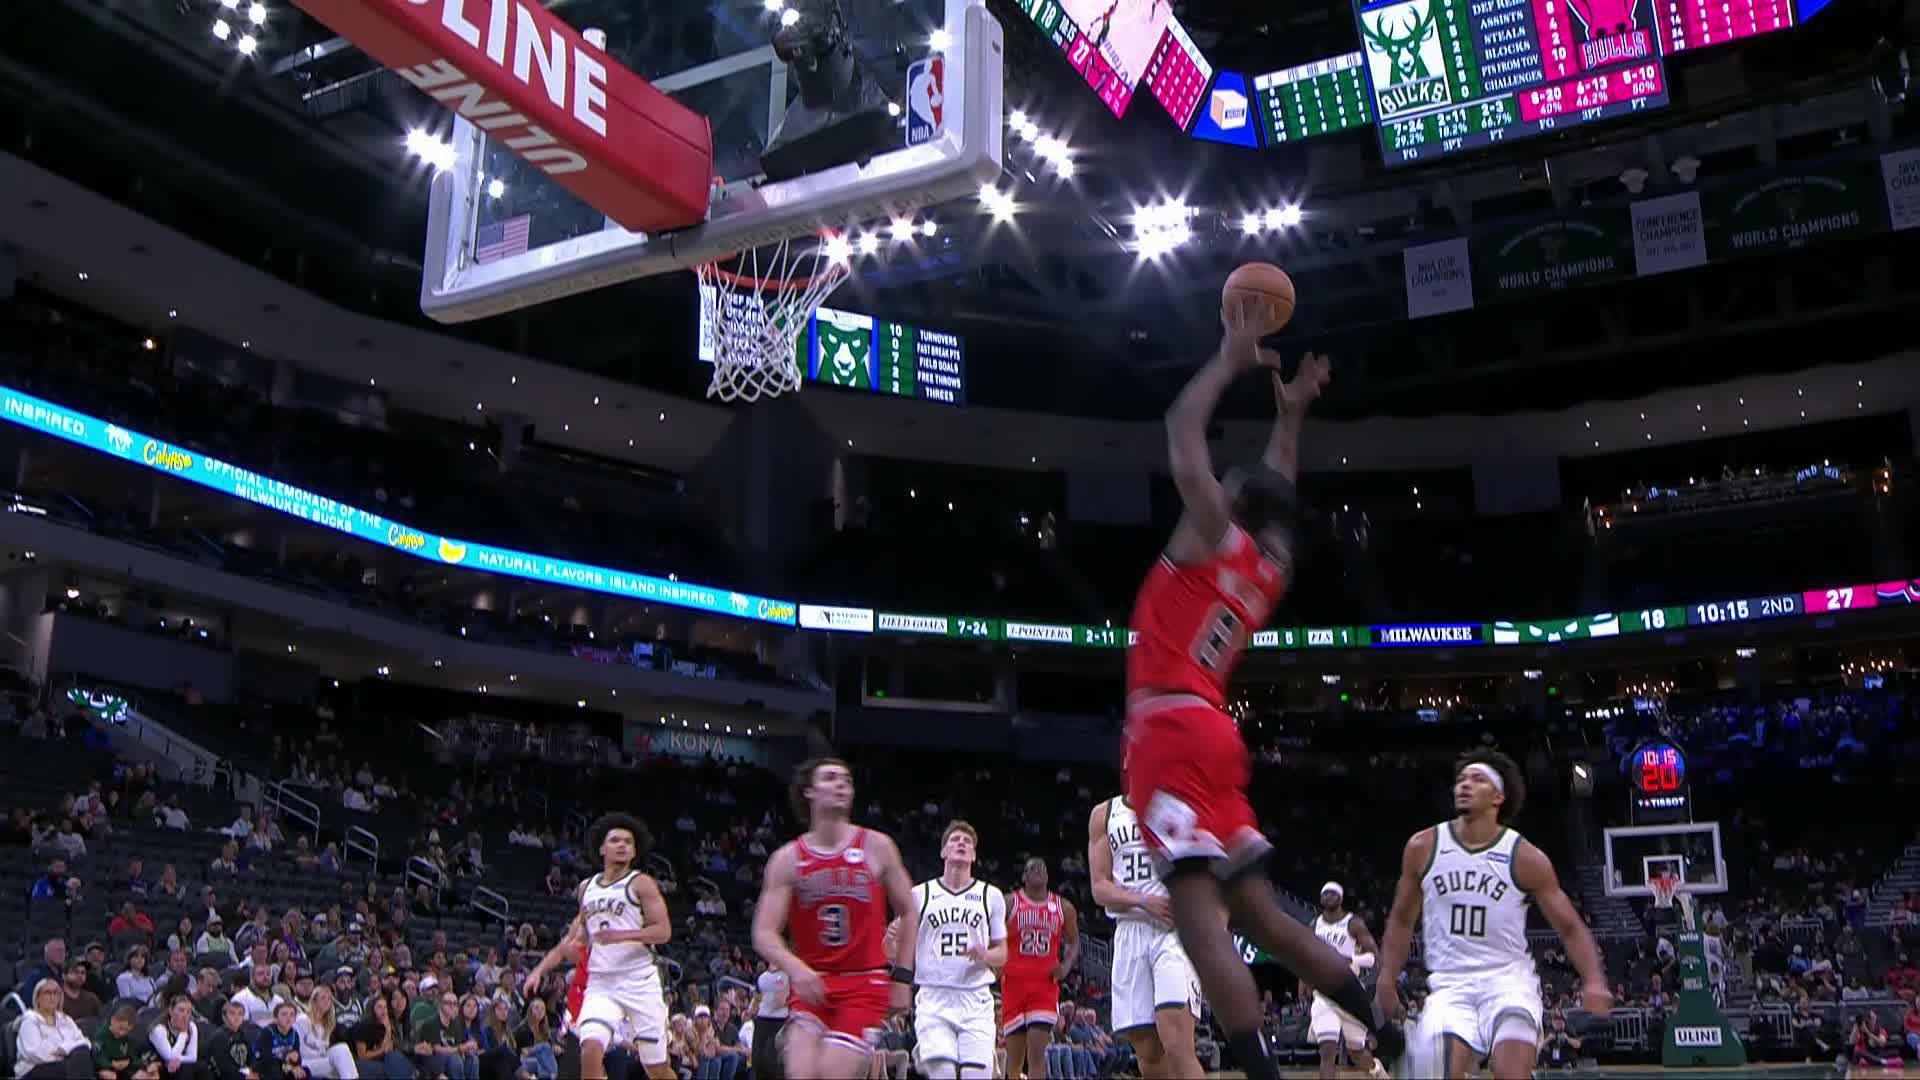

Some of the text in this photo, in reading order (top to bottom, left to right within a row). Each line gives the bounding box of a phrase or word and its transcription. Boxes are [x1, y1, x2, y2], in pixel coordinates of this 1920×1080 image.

[1484, 26, 1526, 45] STEALS
[1485, 40, 1530, 60] BLOCKS
[1552, 47, 1566, 60] 10
[1583, 31, 1647, 70] BULLS
[408, 0, 607, 138] LINE
[1461, 85, 1469, 98] 0
[1484, 70, 1542, 92] CHALLENGES
[1577, 77, 1607, 95] 6-13
[1380, 81, 1444, 113] BUCKS
[394, 58, 588, 174] ULINE
[1394, 118, 1424, 136] 7-24
[911, 125, 930, 142] NBA
[1731, 209, 1859, 248] WORLD CHAMPIONS
[1499, 271, 1540, 289] WORLD
[1544, 256, 1616, 282] CHAMPIONS
[890, 323, 957, 347] 10 TURNOVERS
[892, 337, 899, 350] 0
[917, 342, 930, 354] FAST
[931, 344, 949, 359] BREAK
[892, 351, 958, 374] 7 FIELD GOALS
[917, 371, 934, 384] FREE
[935, 374, 961, 389] THROWS
[925, 387, 954, 402] THREES
[4, 397, 88, 440] INSPIRED.
[143, 439, 192, 470] Calypso
[204, 456, 381, 529] OFFICIAL LEMONADE OF THE
[235, 483, 351, 532] MILWAUKEE BUCKS
[388, 523, 425, 550] Calypso
[479, 551, 541, 574] NATURAL
[609, 575, 656, 594] ISLAND
[758, 599, 794, 621] Calypso
[1697, 597, 1794, 623] 10:15 2ND
[1826, 588, 1853, 610] 27
[881, 617, 910, 628] FIELD
[911, 619, 945, 631] GOALS
[958, 619, 988, 637] 7-24
[1640, 609, 1665, 630] 18
[1086, 628, 1115, 646] 2-11
[1381, 626, 1472, 643] MILWAUKEE
[671, 731, 724, 754] KONA
[1643, 749, 1676, 765] 10:15
[1643, 764, 1677, 790] 20
[1650, 797, 1685, 808] TISSOT
[1122, 853, 1151, 882] 35
[1432, 870, 1508, 902] BUCKS
[816, 904, 849, 946] 3
[928, 907, 983, 929] BUCKS
[1450, 903, 1487, 937] 00
[941, 933, 969, 956] 25
[1020, 929, 1051, 956] 25
[1678, 1030, 1719, 1043] ULINE
